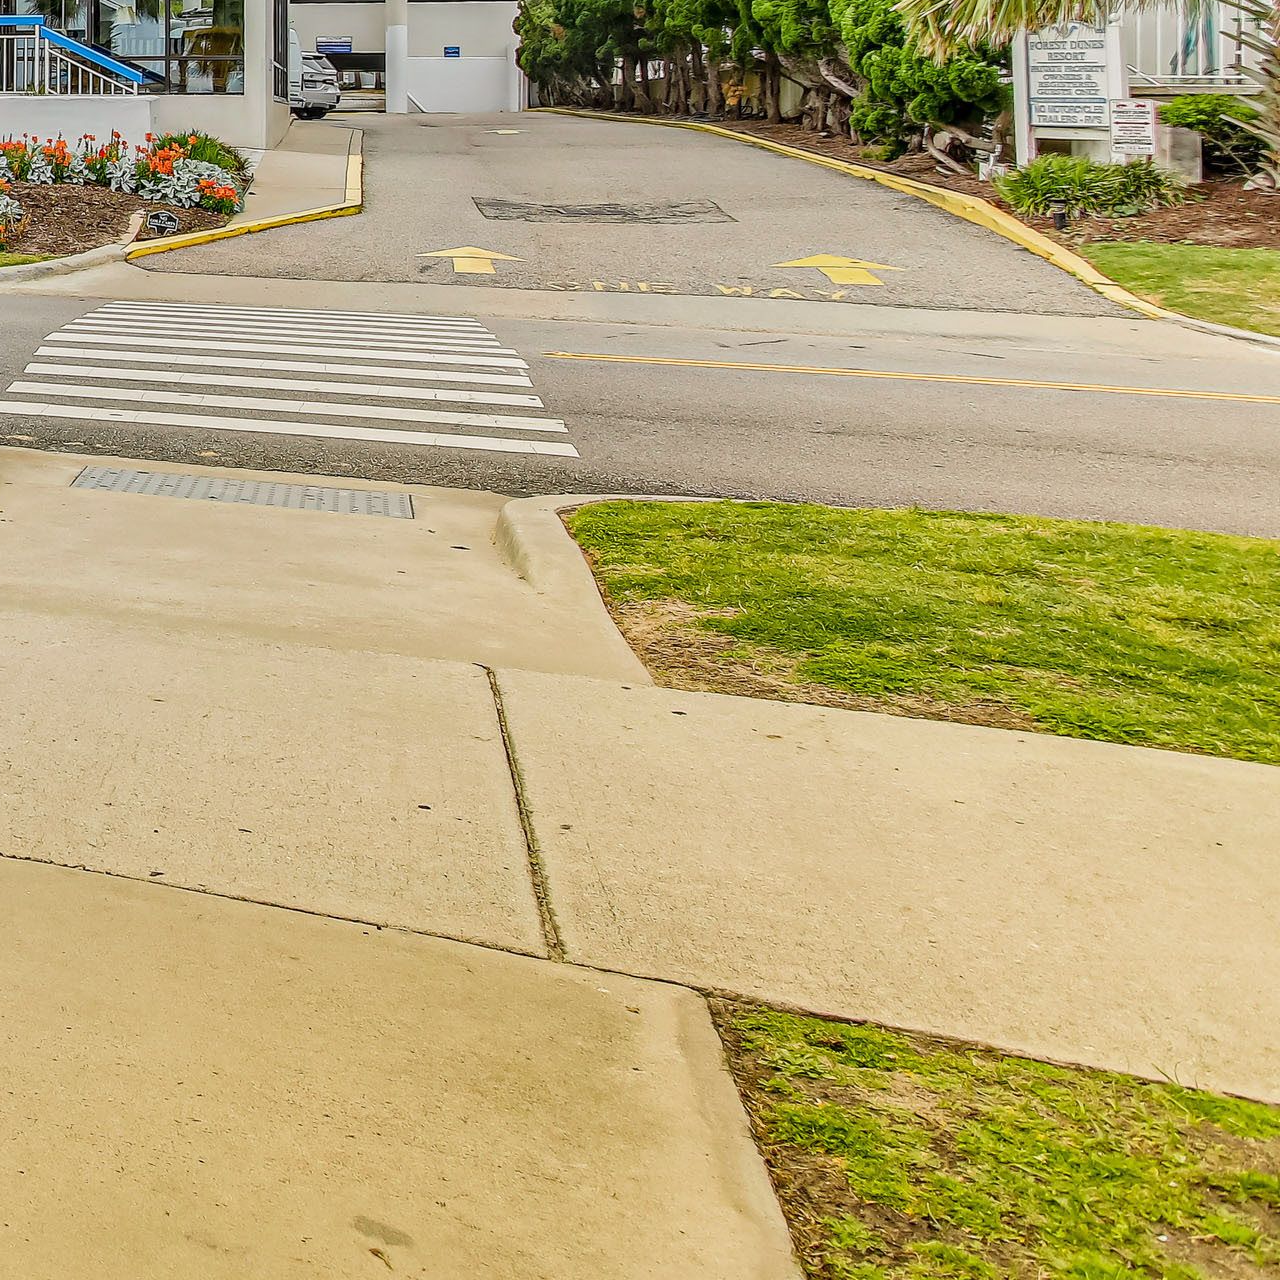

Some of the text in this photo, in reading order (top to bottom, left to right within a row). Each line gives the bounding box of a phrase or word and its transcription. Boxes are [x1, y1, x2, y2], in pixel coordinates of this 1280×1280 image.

[1029, 40, 1104, 50] FOREST DUNES
[1047, 52, 1086, 61] RESORT
[1031, 65, 1105, 73] PRIVATE PROPERTY
[1035, 105, 1104, 114] NO MOTORCYCLES
[1037, 114, 1078, 124] TRAILERS
[546, 281, 847, 300] ONE WAY
